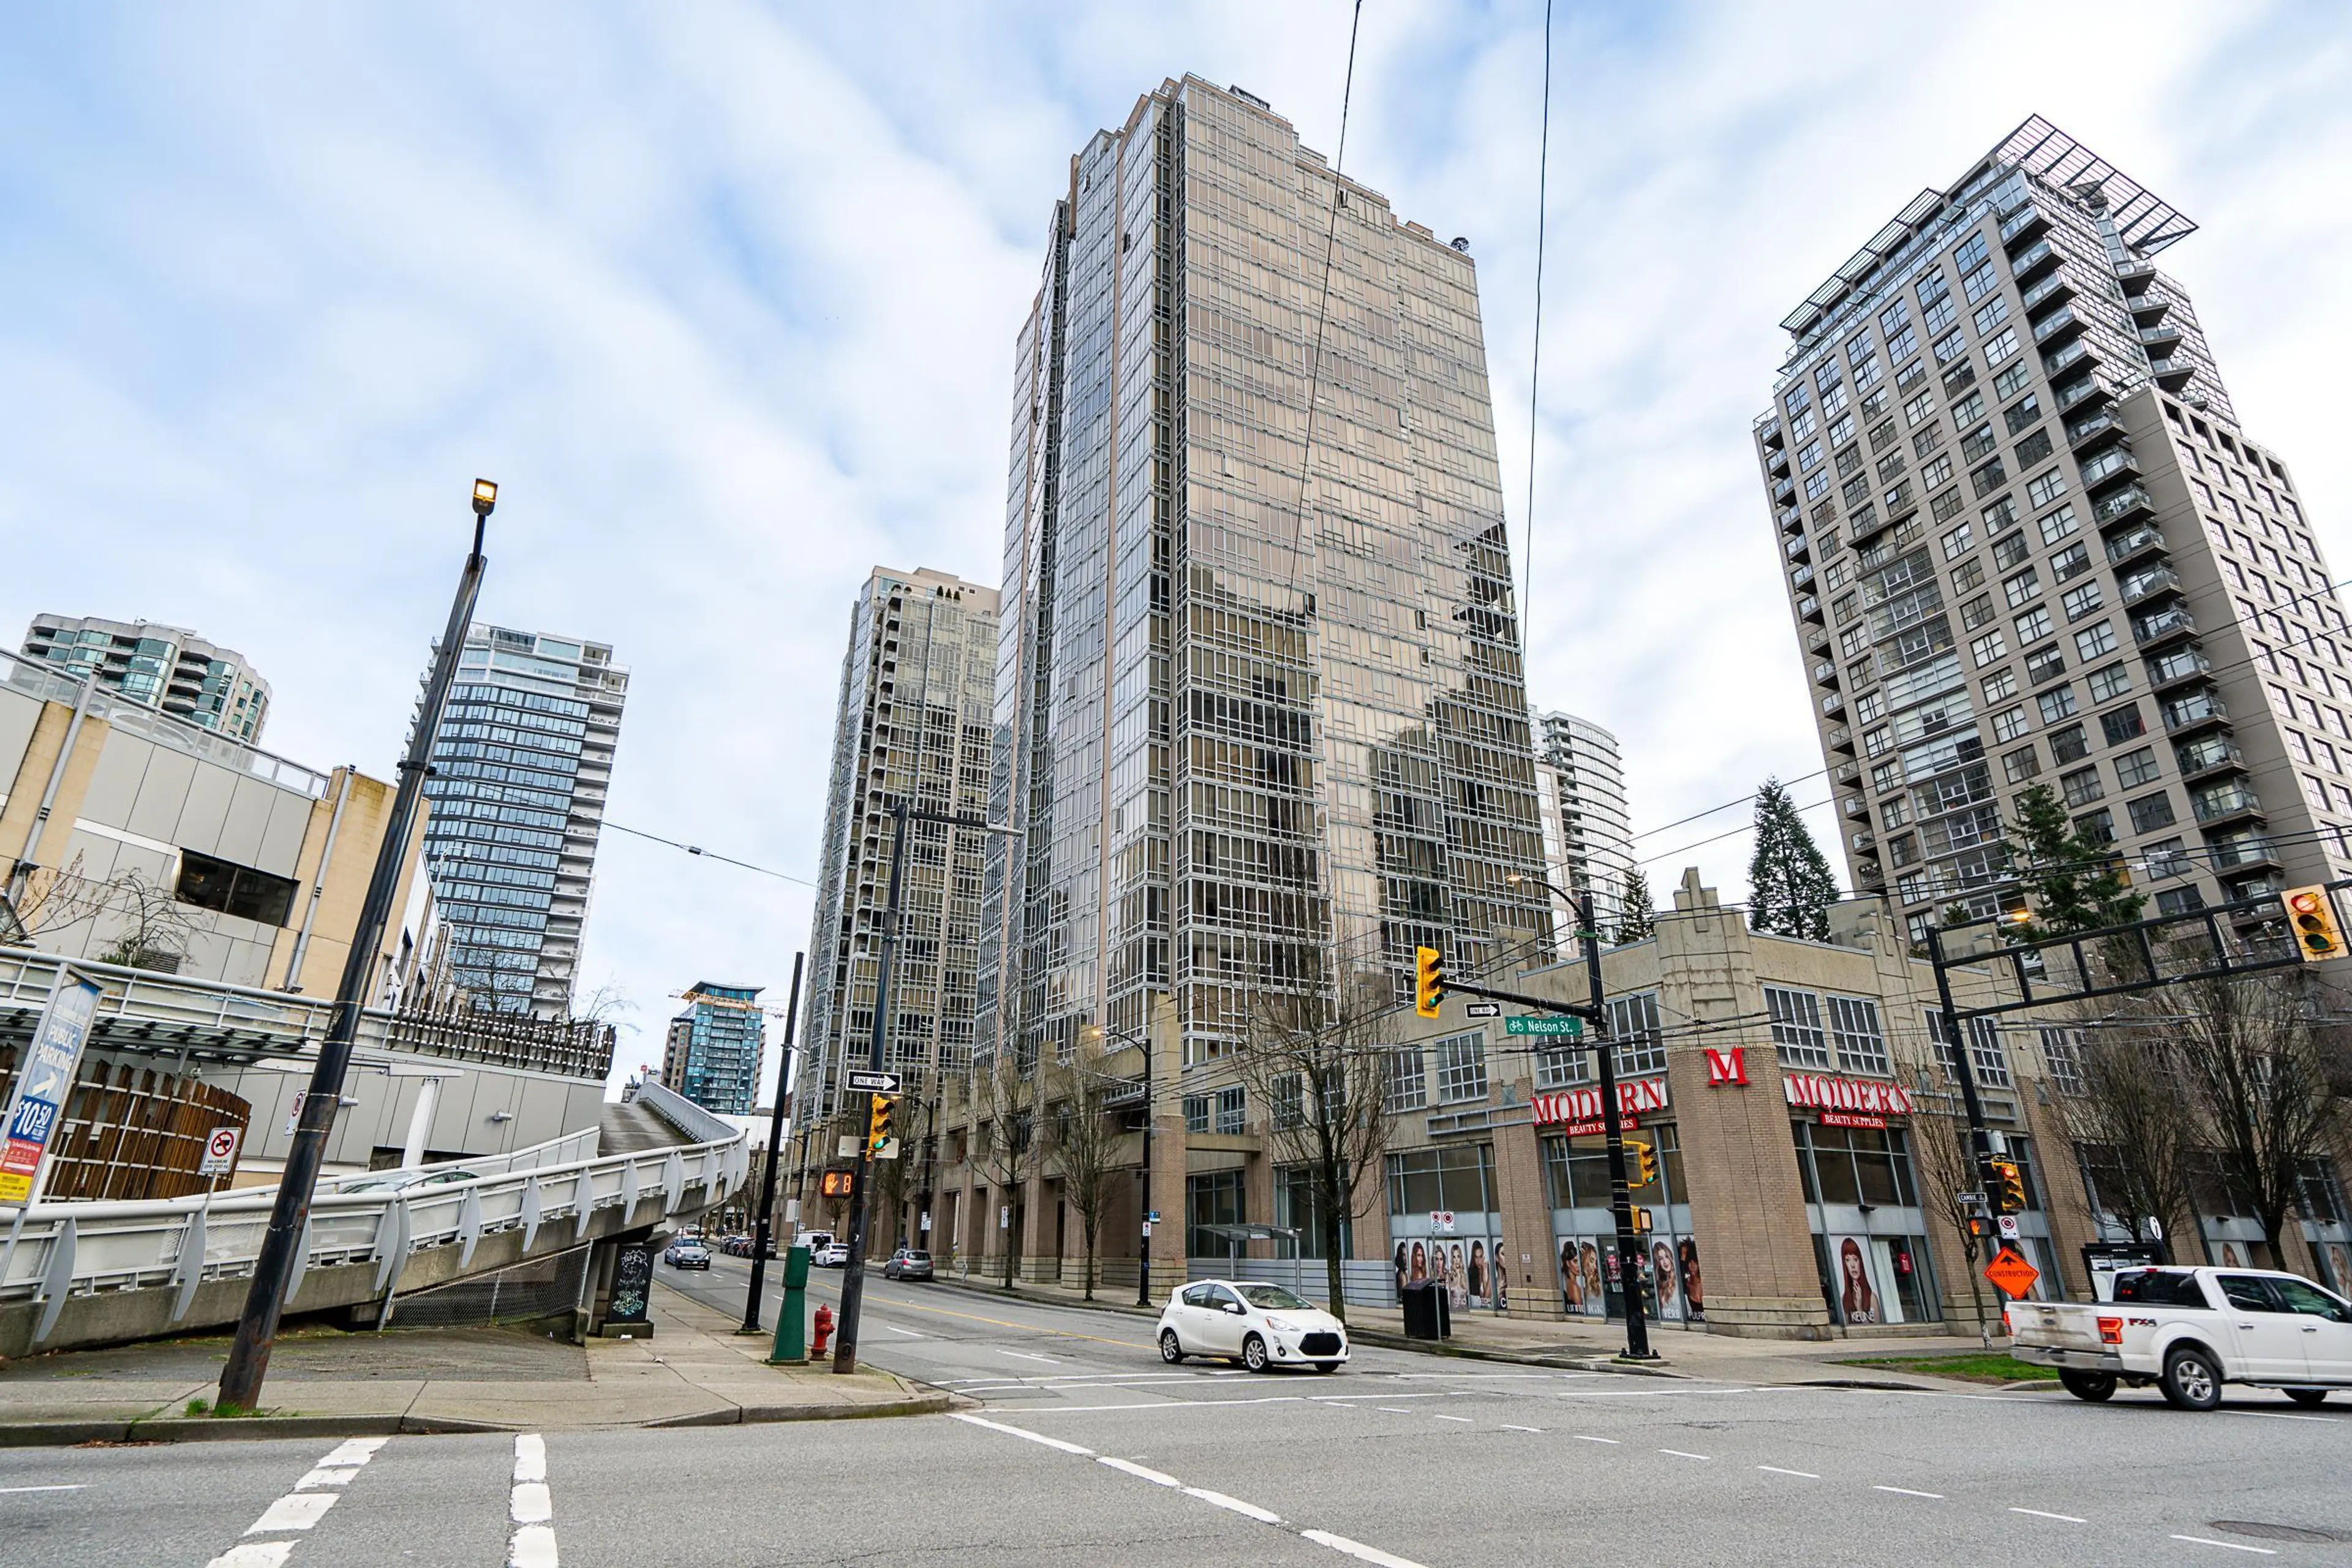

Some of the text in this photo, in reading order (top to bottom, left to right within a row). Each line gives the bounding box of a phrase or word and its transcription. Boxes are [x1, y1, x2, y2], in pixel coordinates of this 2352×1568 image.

[47, 1024, 77, 1049] PUBLIC
[1528, 1020, 1573, 1032] Nelson St.
[1704, 1047, 1750, 1086] M
[1530, 1077, 1664, 1126] MODRN
[1788, 1074, 1913, 1115] MODERN
[1569, 1123, 1597, 1135] BEAUTY
[1824, 1114, 1885, 1128] BEAUTY SUPPLIES
[843, 1175, 852, 1193] 8
